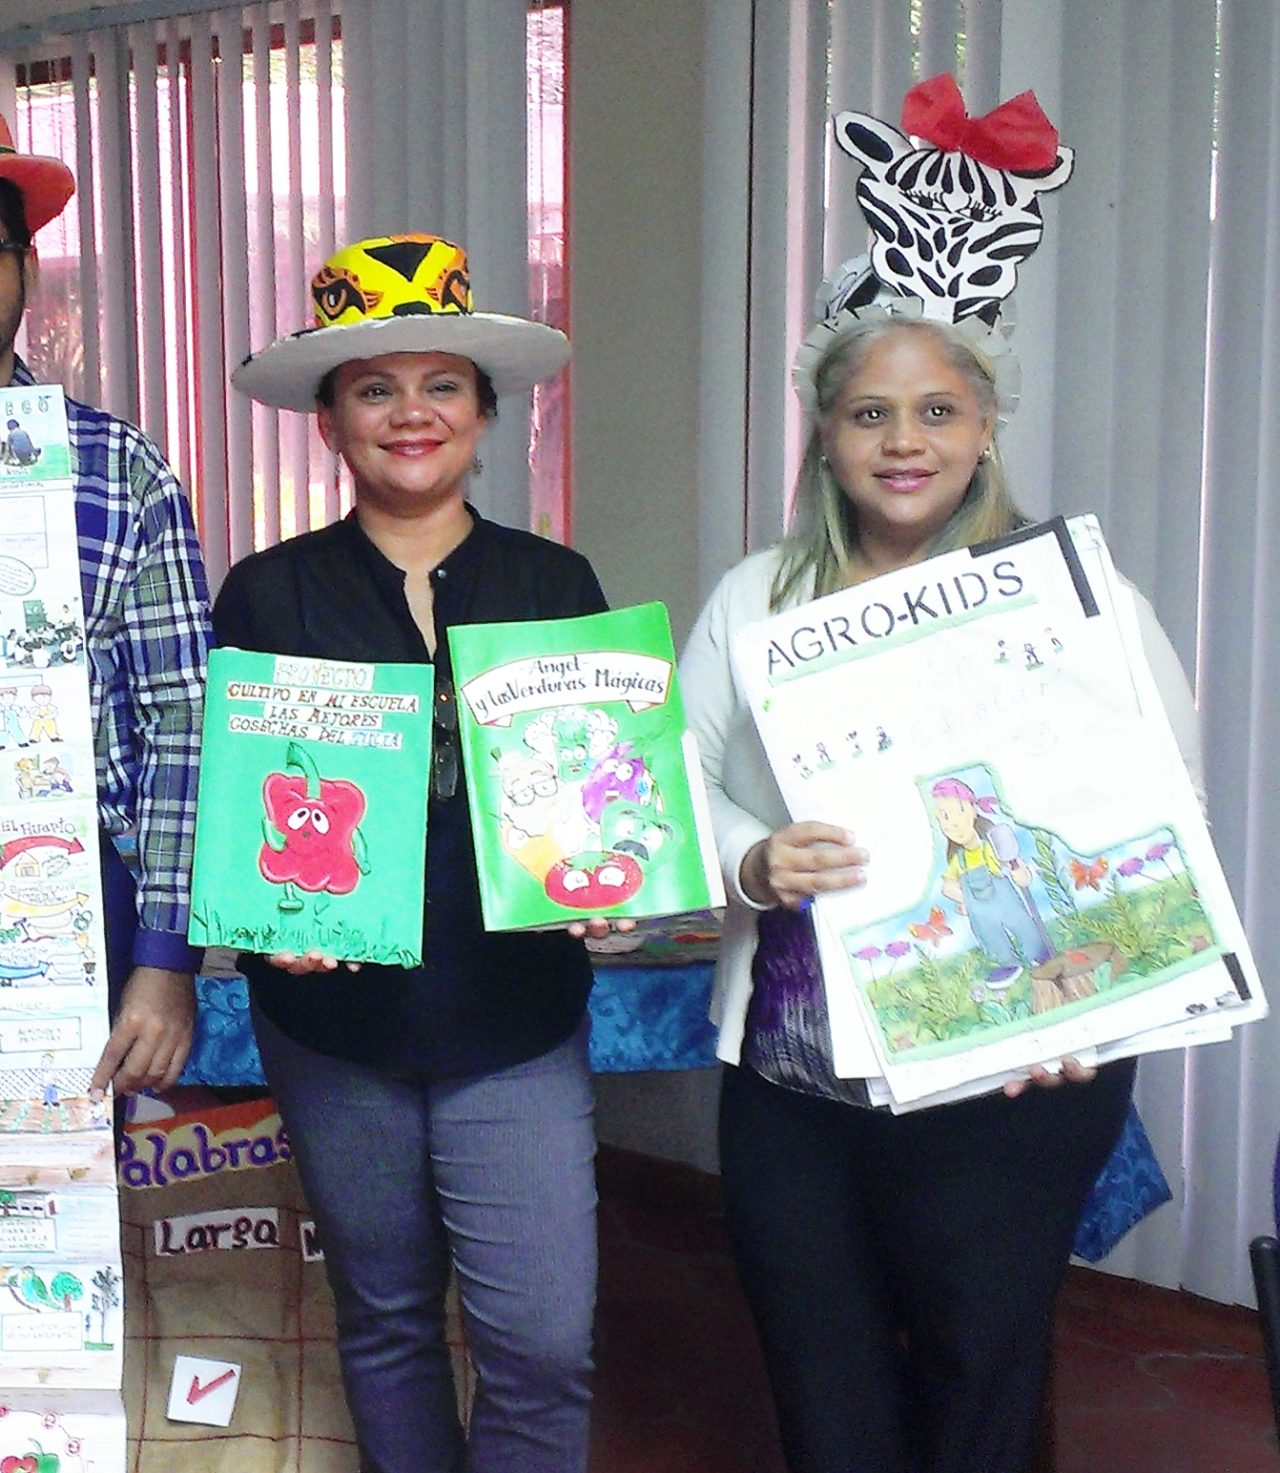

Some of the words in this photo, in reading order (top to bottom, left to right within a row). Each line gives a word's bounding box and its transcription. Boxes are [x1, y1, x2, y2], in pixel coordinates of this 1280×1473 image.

[767, 560, 1024, 676] AGRO-KIDS
[228, 683, 292, 702] CULTIVO
[298, 690, 317, 703] EN
[325, 694, 345, 709] MI
[351, 695, 417, 713] ESCUELA
[269, 705, 299, 721] LAS
[230, 717, 309, 739] COSECHAS
[319, 727, 345, 743] DEL
[161, 1215, 280, 1254] Larga
